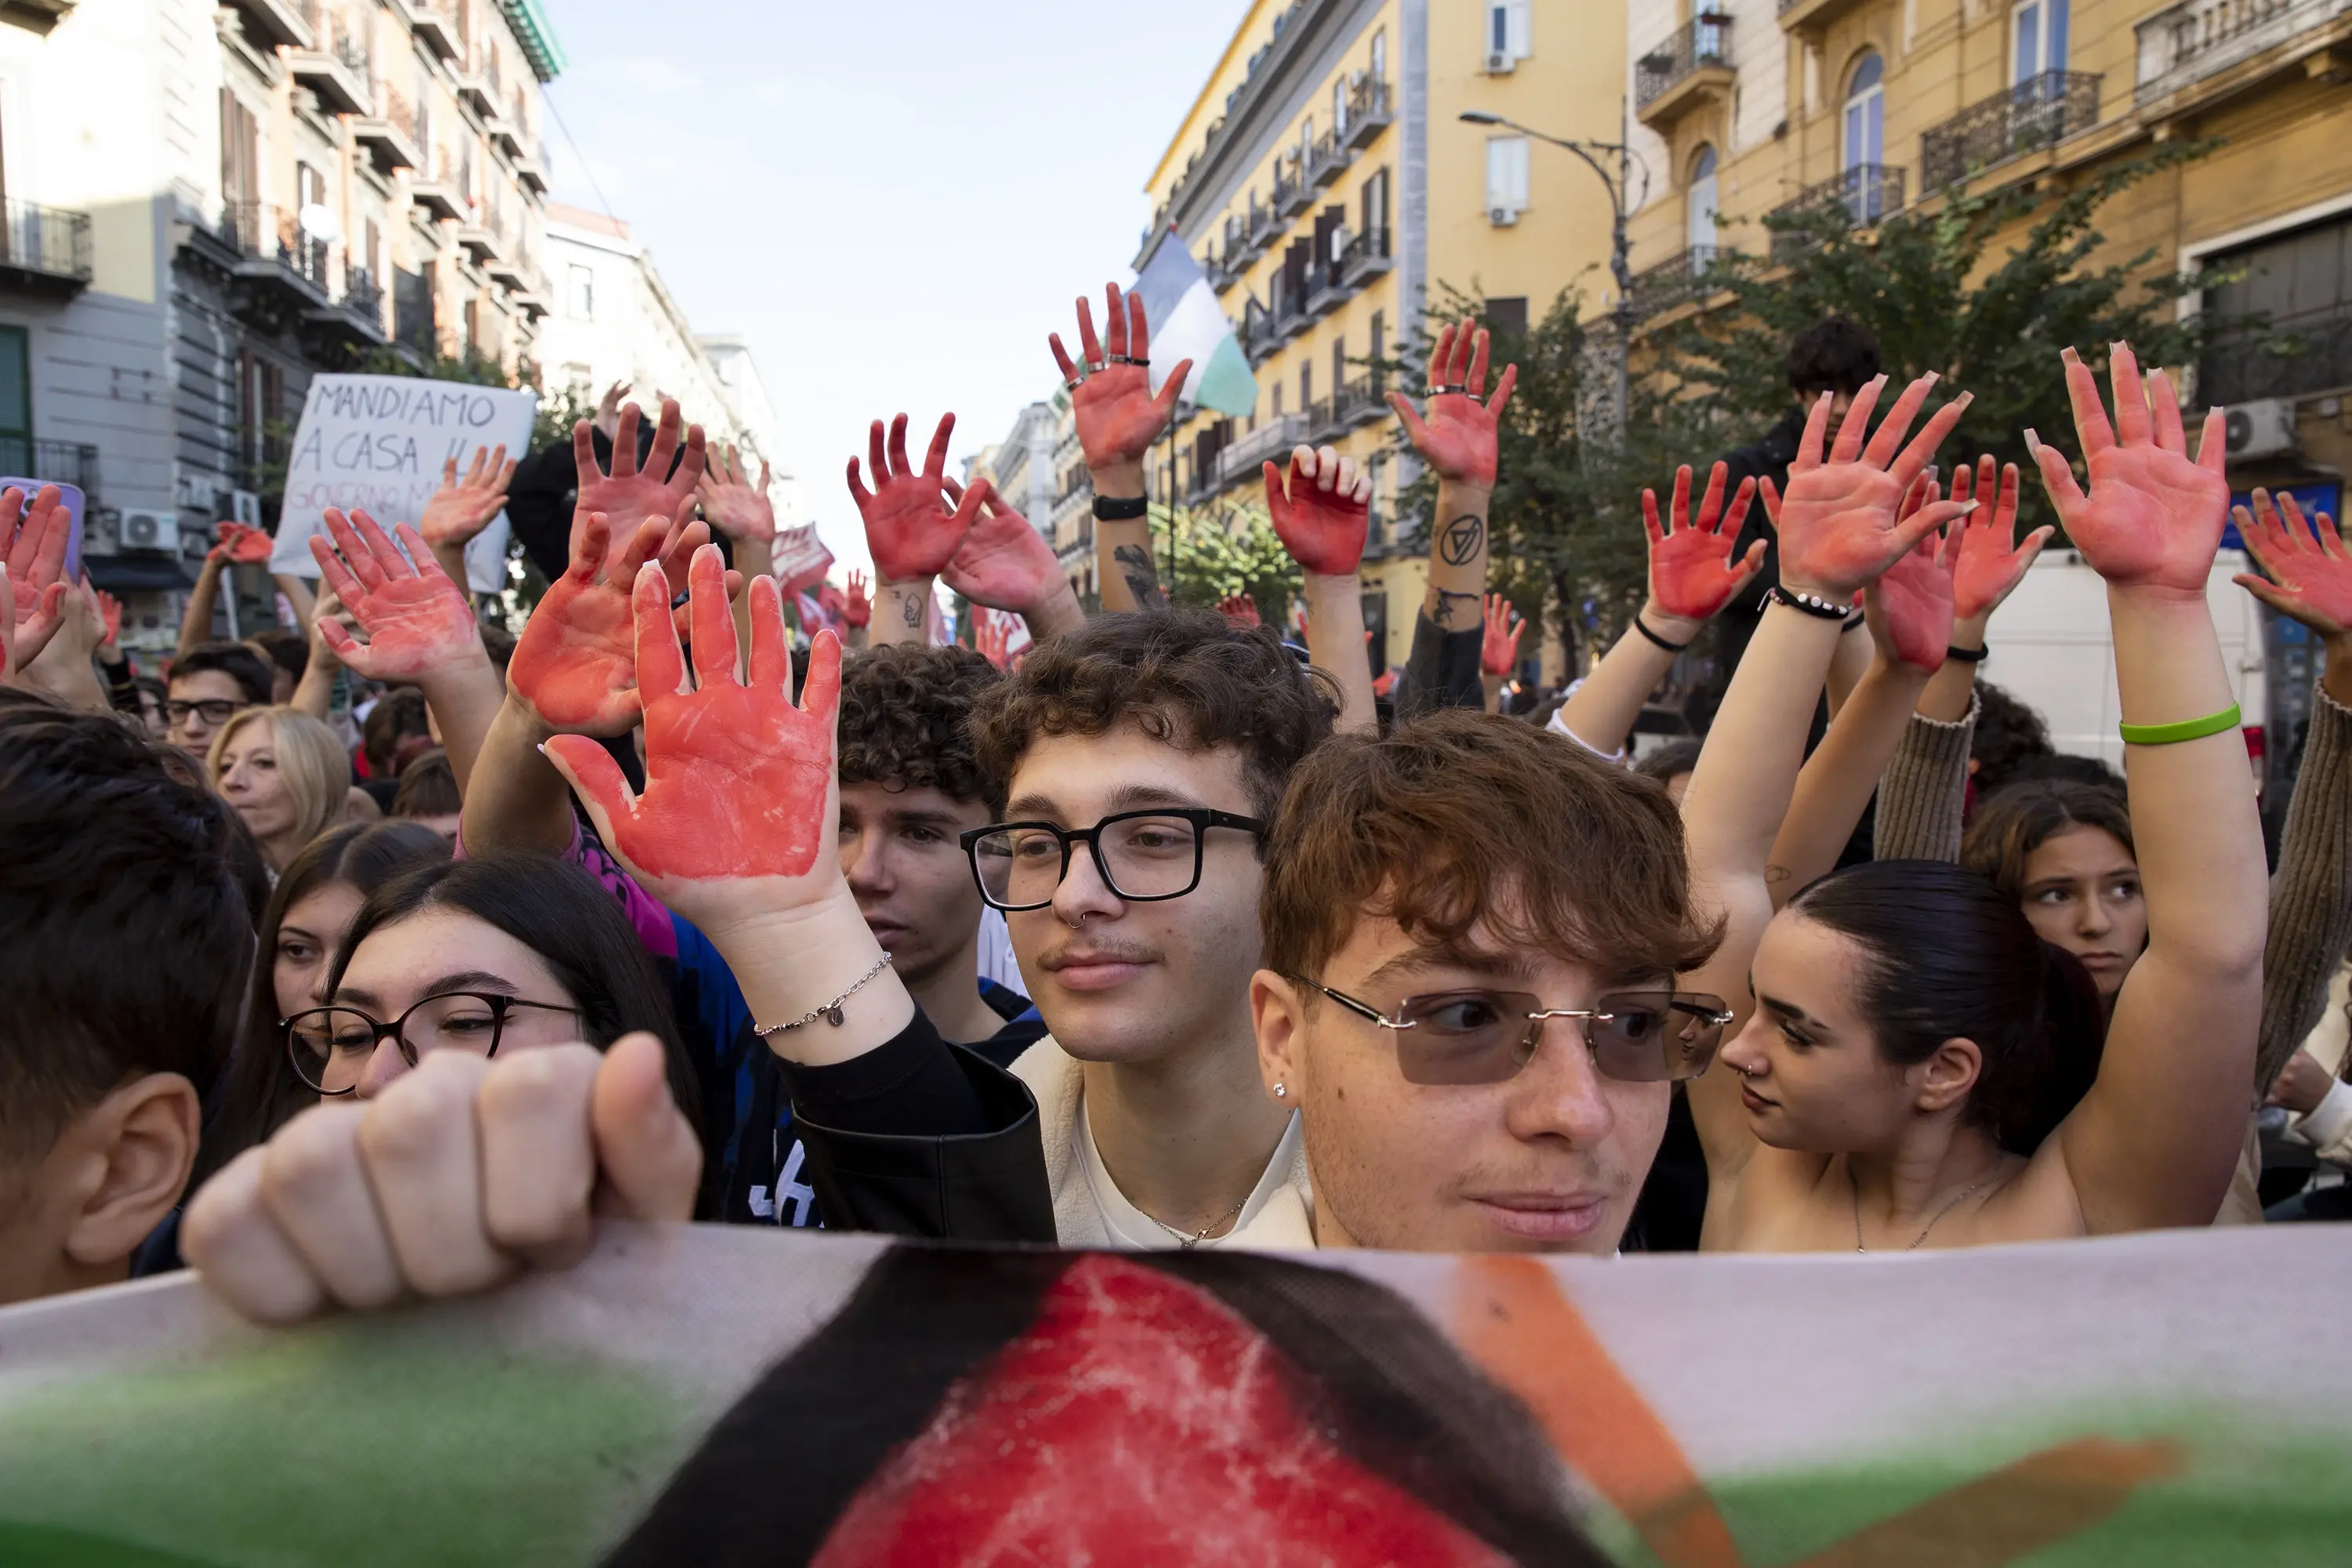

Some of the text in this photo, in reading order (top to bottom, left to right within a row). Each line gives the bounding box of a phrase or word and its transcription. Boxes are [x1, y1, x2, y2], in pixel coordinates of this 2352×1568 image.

[314, 383, 495, 428] MANDIAMO
[292, 426, 322, 473] A
[332, 431, 419, 475] CASA
